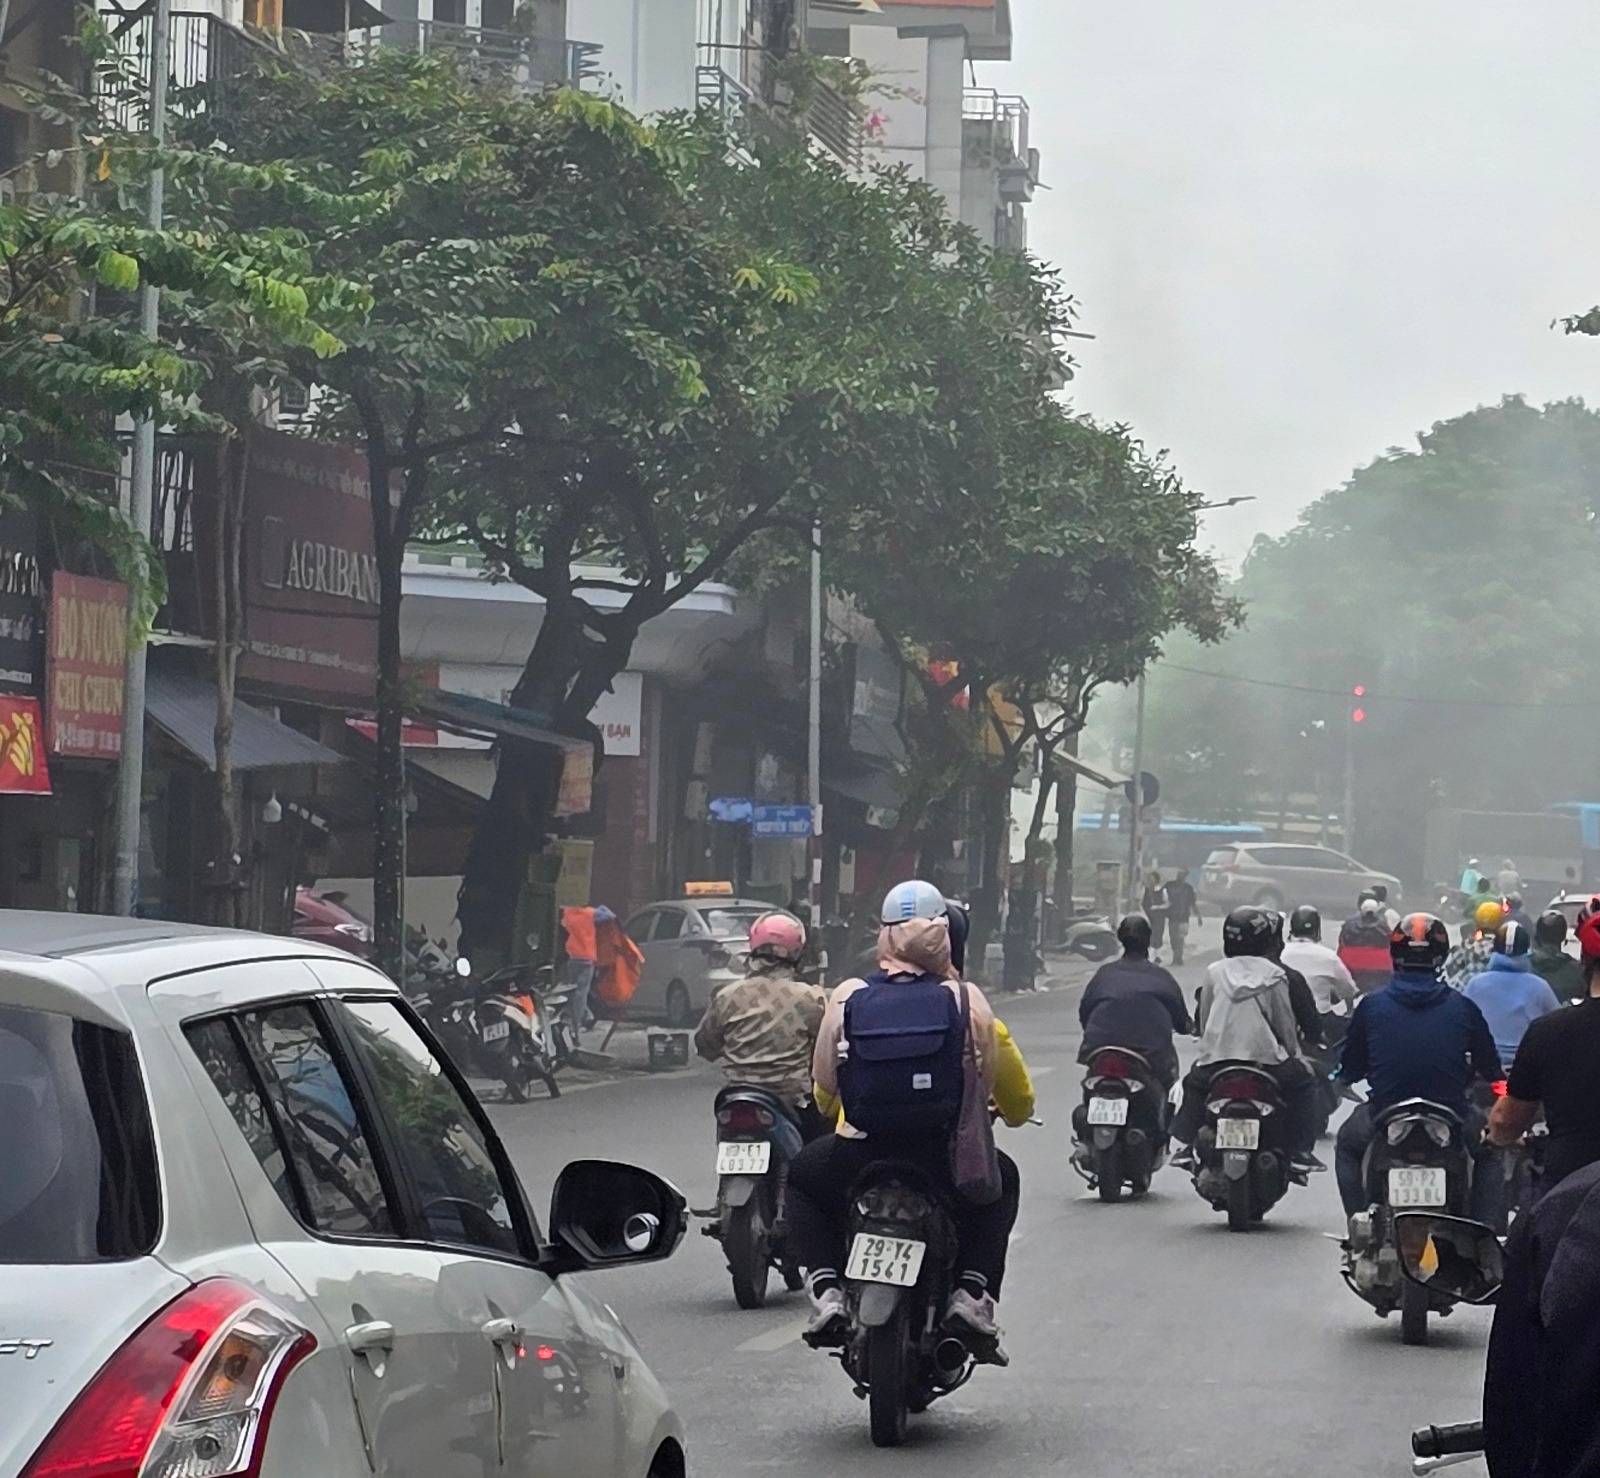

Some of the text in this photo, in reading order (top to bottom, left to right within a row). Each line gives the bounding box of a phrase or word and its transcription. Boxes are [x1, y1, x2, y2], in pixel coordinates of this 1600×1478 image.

[287, 539, 381, 605] AGRIBAN
[83, 673, 125, 717] CHUN
[860, 1258, 908, 1282] 1541
